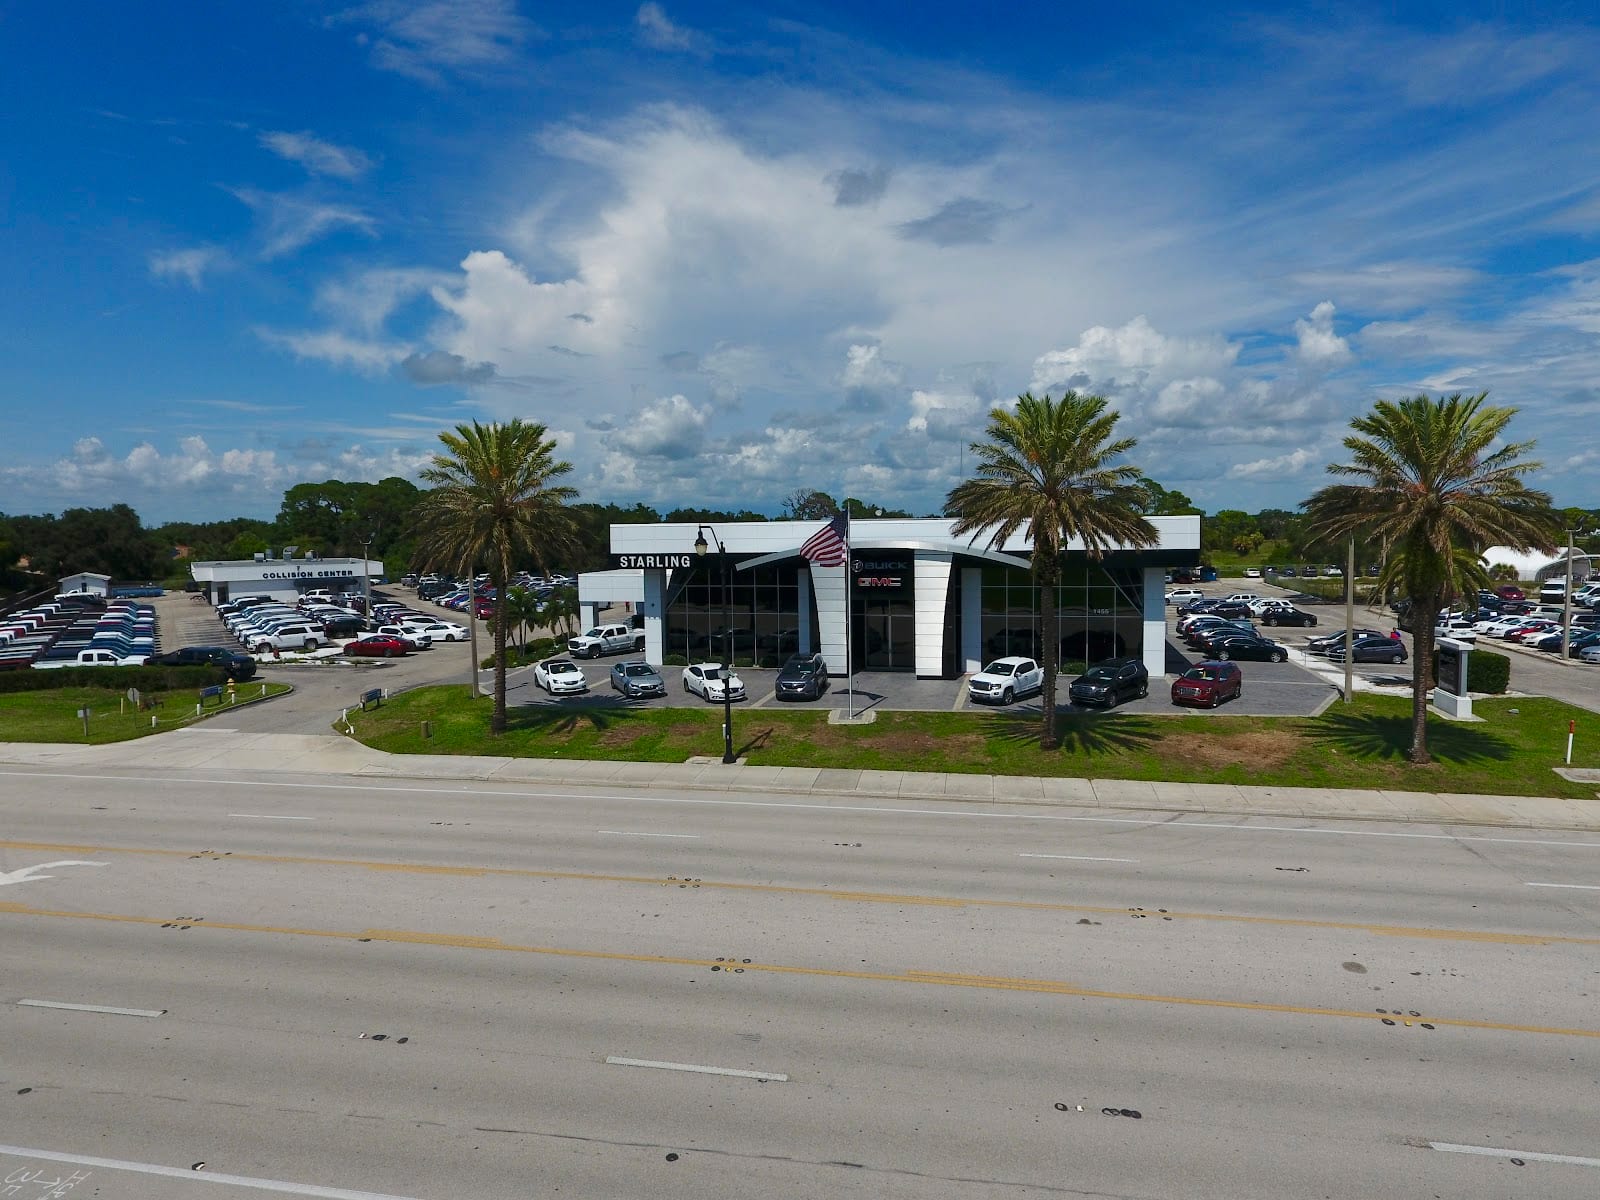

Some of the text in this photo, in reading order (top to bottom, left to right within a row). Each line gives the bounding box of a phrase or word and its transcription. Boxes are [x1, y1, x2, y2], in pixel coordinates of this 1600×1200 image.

[620, 555, 690, 568] STARLING
[864, 561, 907, 570] BUICK
[262, 571, 313, 579] COLLISION
[857, 577, 902, 587] GMC
